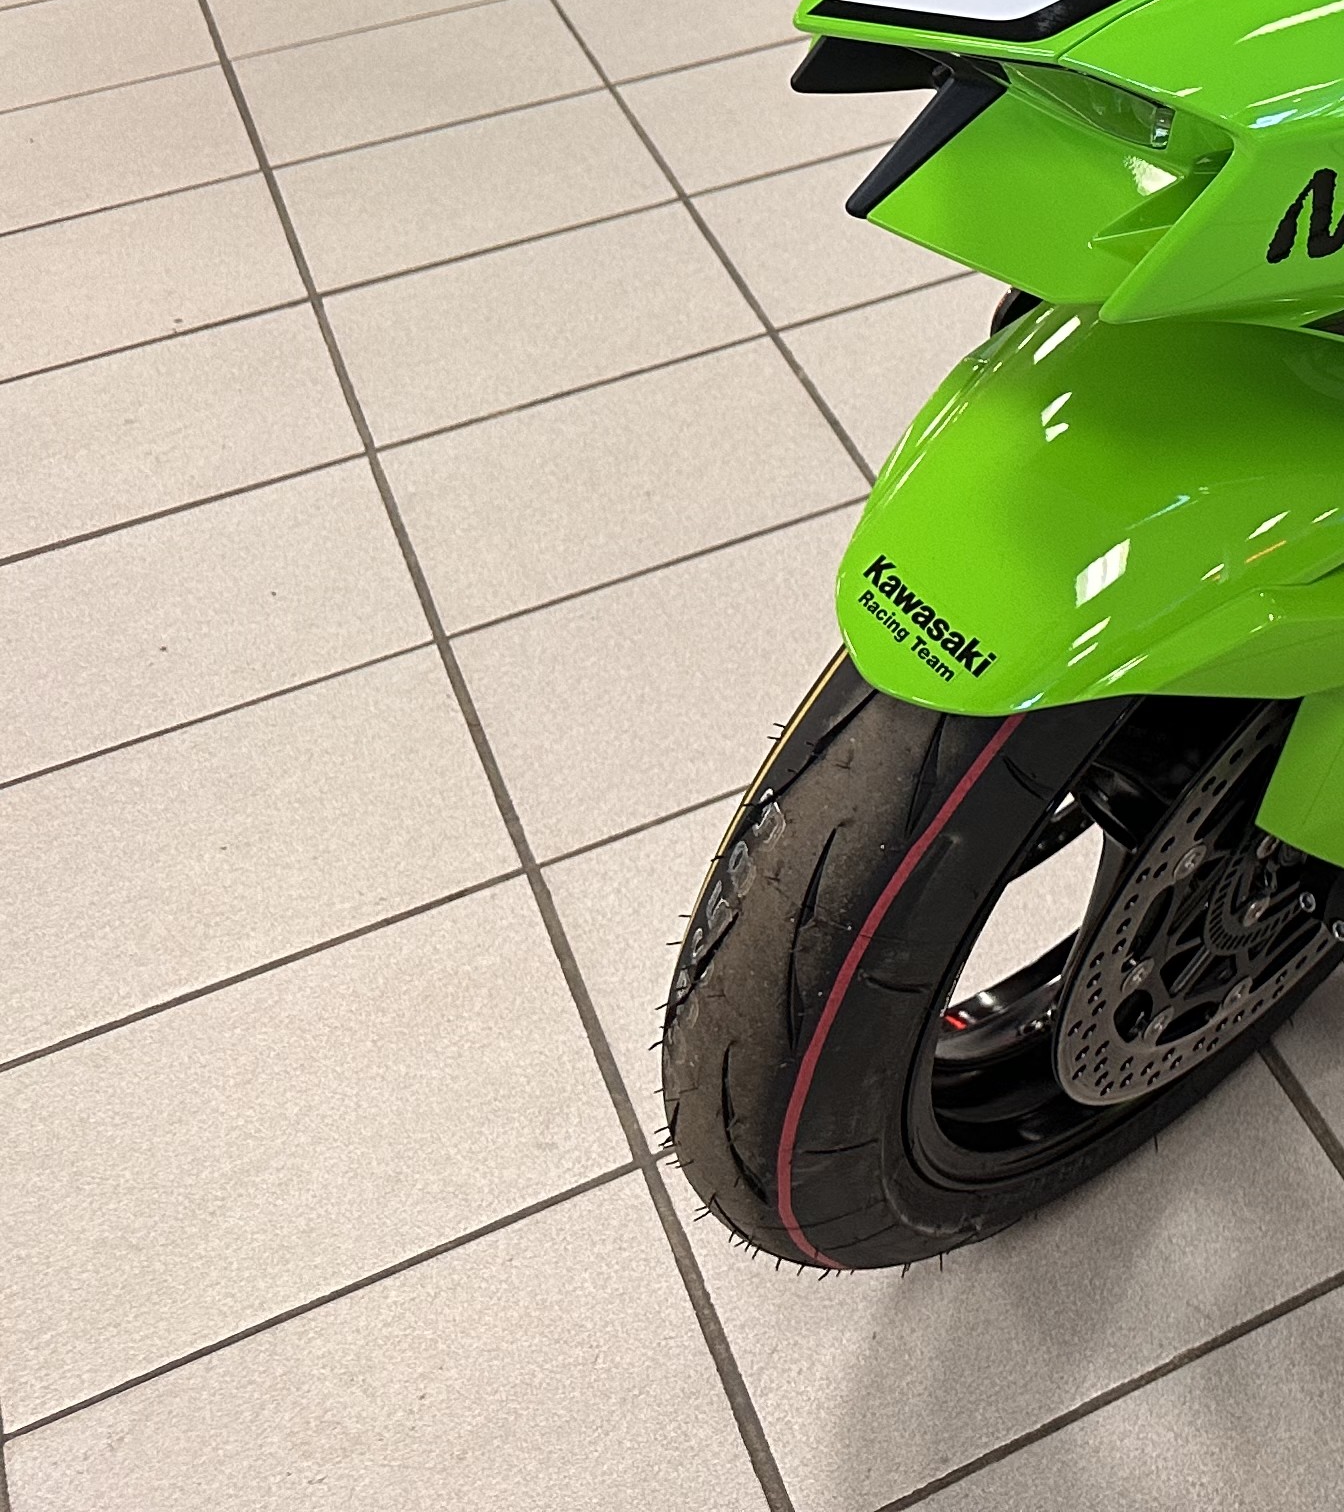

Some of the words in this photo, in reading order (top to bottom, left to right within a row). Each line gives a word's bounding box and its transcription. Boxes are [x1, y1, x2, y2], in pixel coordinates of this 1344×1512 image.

[857, 588, 910, 643] Racing
[907, 634, 957, 683] Team
[862, 553, 997, 679] Kawasaki
